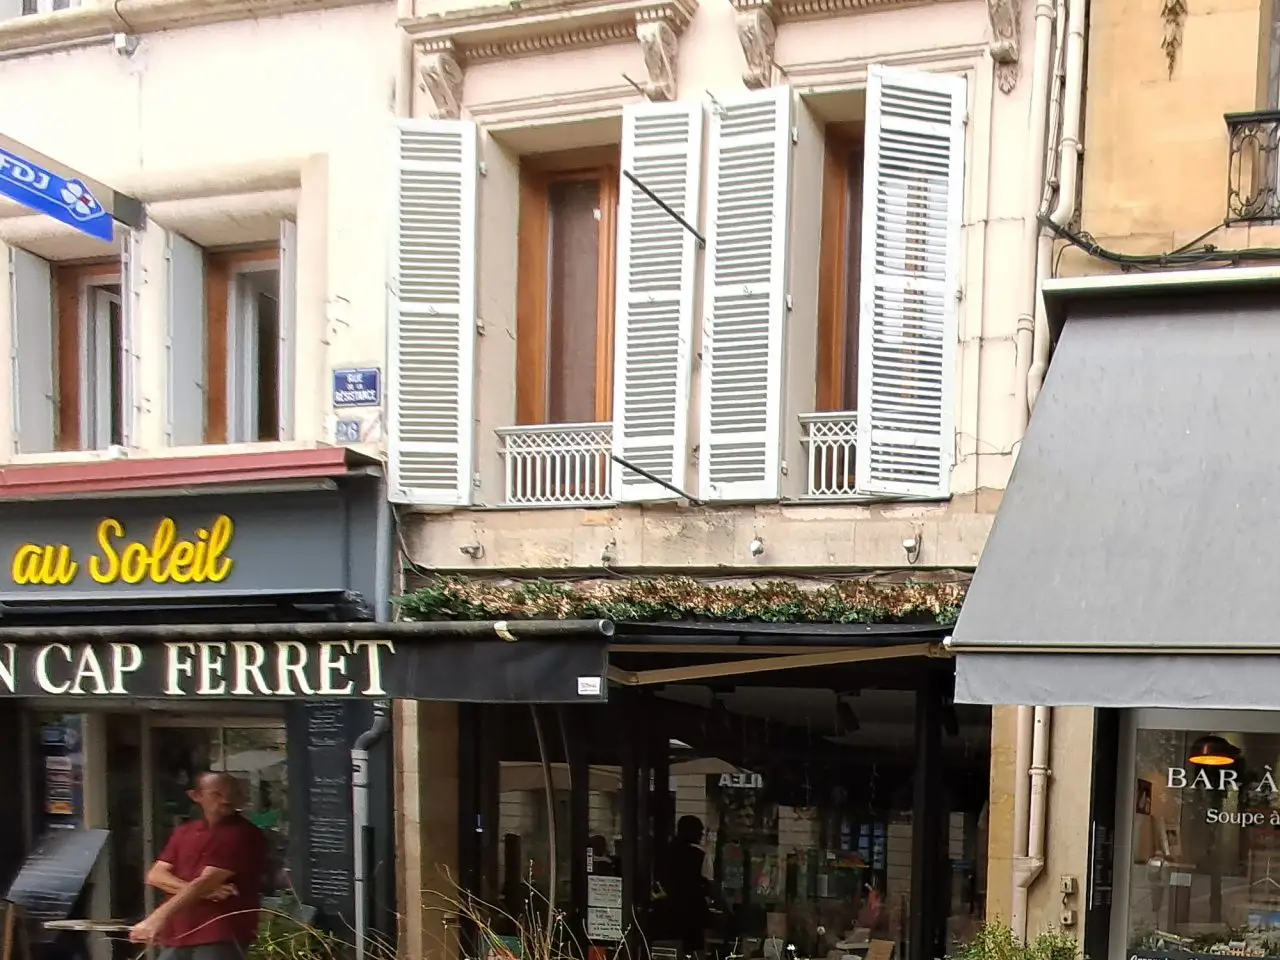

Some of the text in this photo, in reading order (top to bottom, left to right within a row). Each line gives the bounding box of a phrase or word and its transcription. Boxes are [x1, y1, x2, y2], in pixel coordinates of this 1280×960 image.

[12, 513, 235, 585] au Soleil
[35, 642, 143, 695] CAP
[163, 639, 396, 695] FERRET
[1167, 767, 1239, 791] BAR
[1256, 764, 1280, 793] À
[1206, 808, 1265, 827] Soupe
[1270, 810, 1280, 826] à
